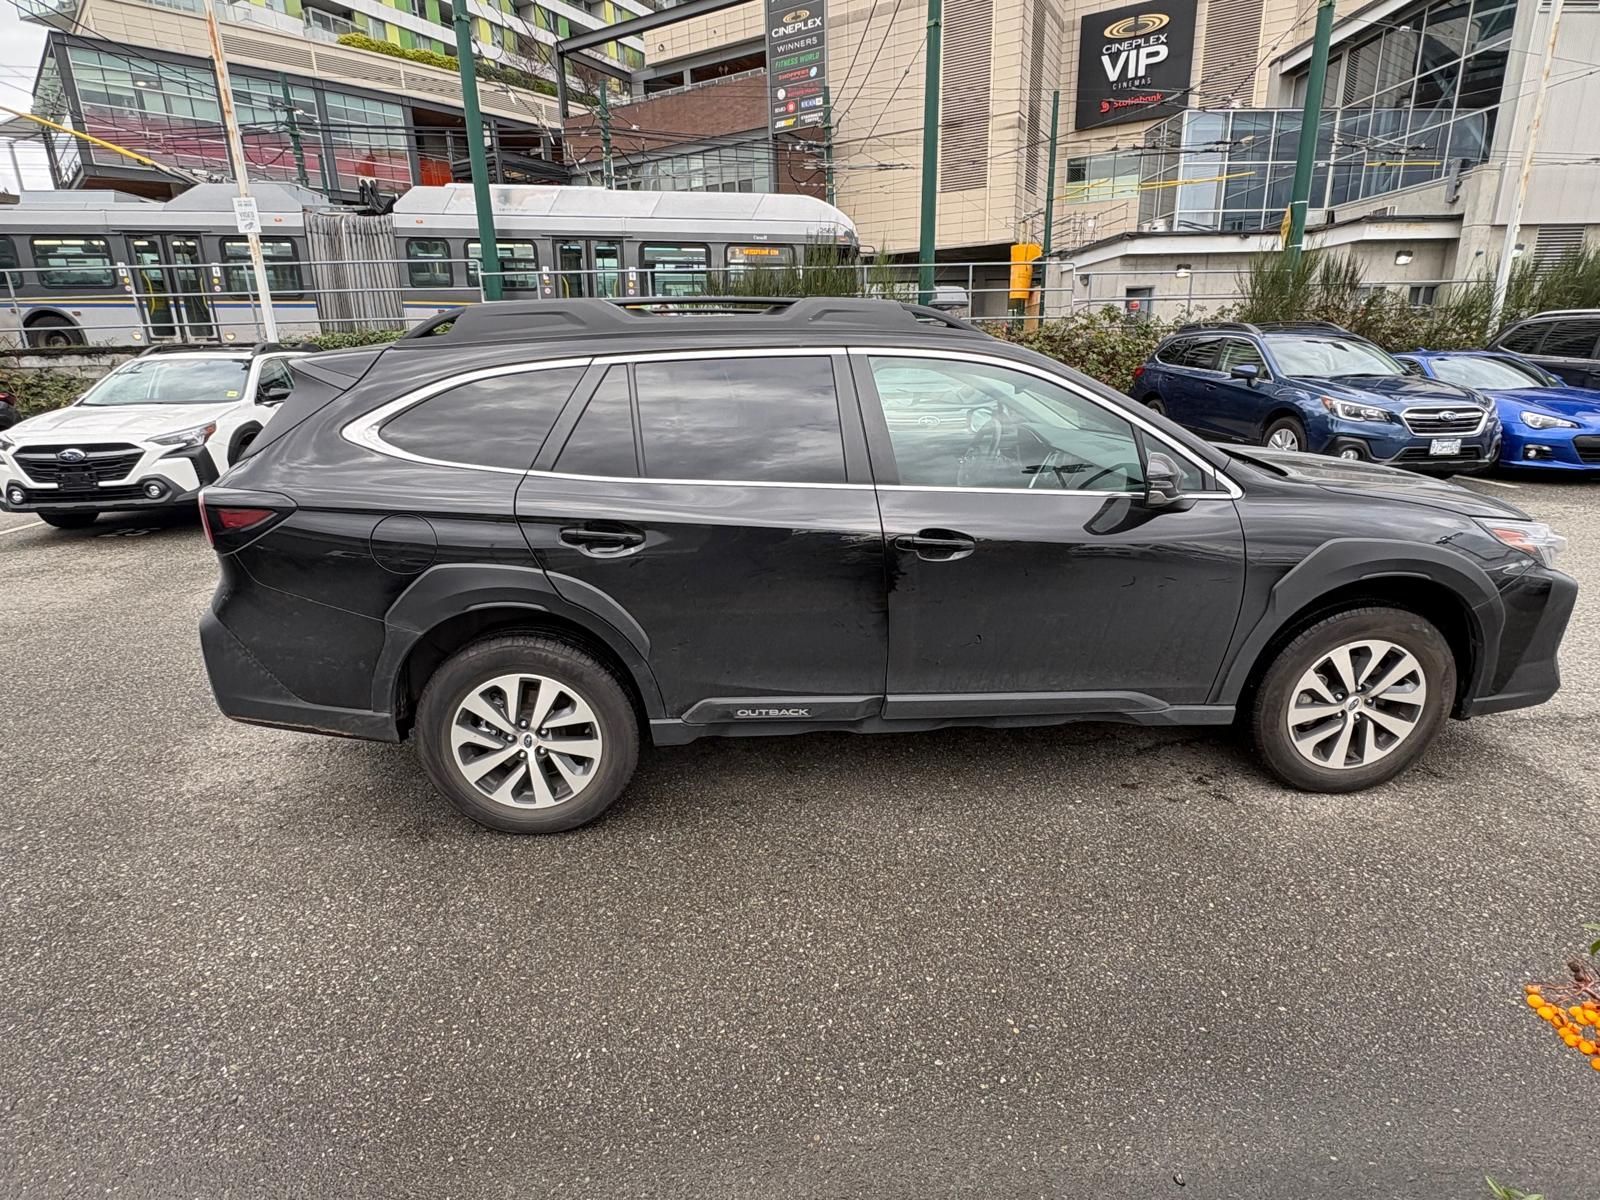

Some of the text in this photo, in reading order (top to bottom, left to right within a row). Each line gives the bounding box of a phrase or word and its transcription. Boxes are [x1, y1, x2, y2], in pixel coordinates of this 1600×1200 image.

[772, 16, 822, 38] CINEPLEX
[777, 36, 818, 53] WINNERS
[1102, 33, 1168, 54] CINEPLEX
[775, 52, 820, 69] FITNESS WORLD
[1101, 44, 1169, 82] VIP
[1112, 78, 1152, 90] CINEMAS
[737, 708, 809, 716] OUTBACK
